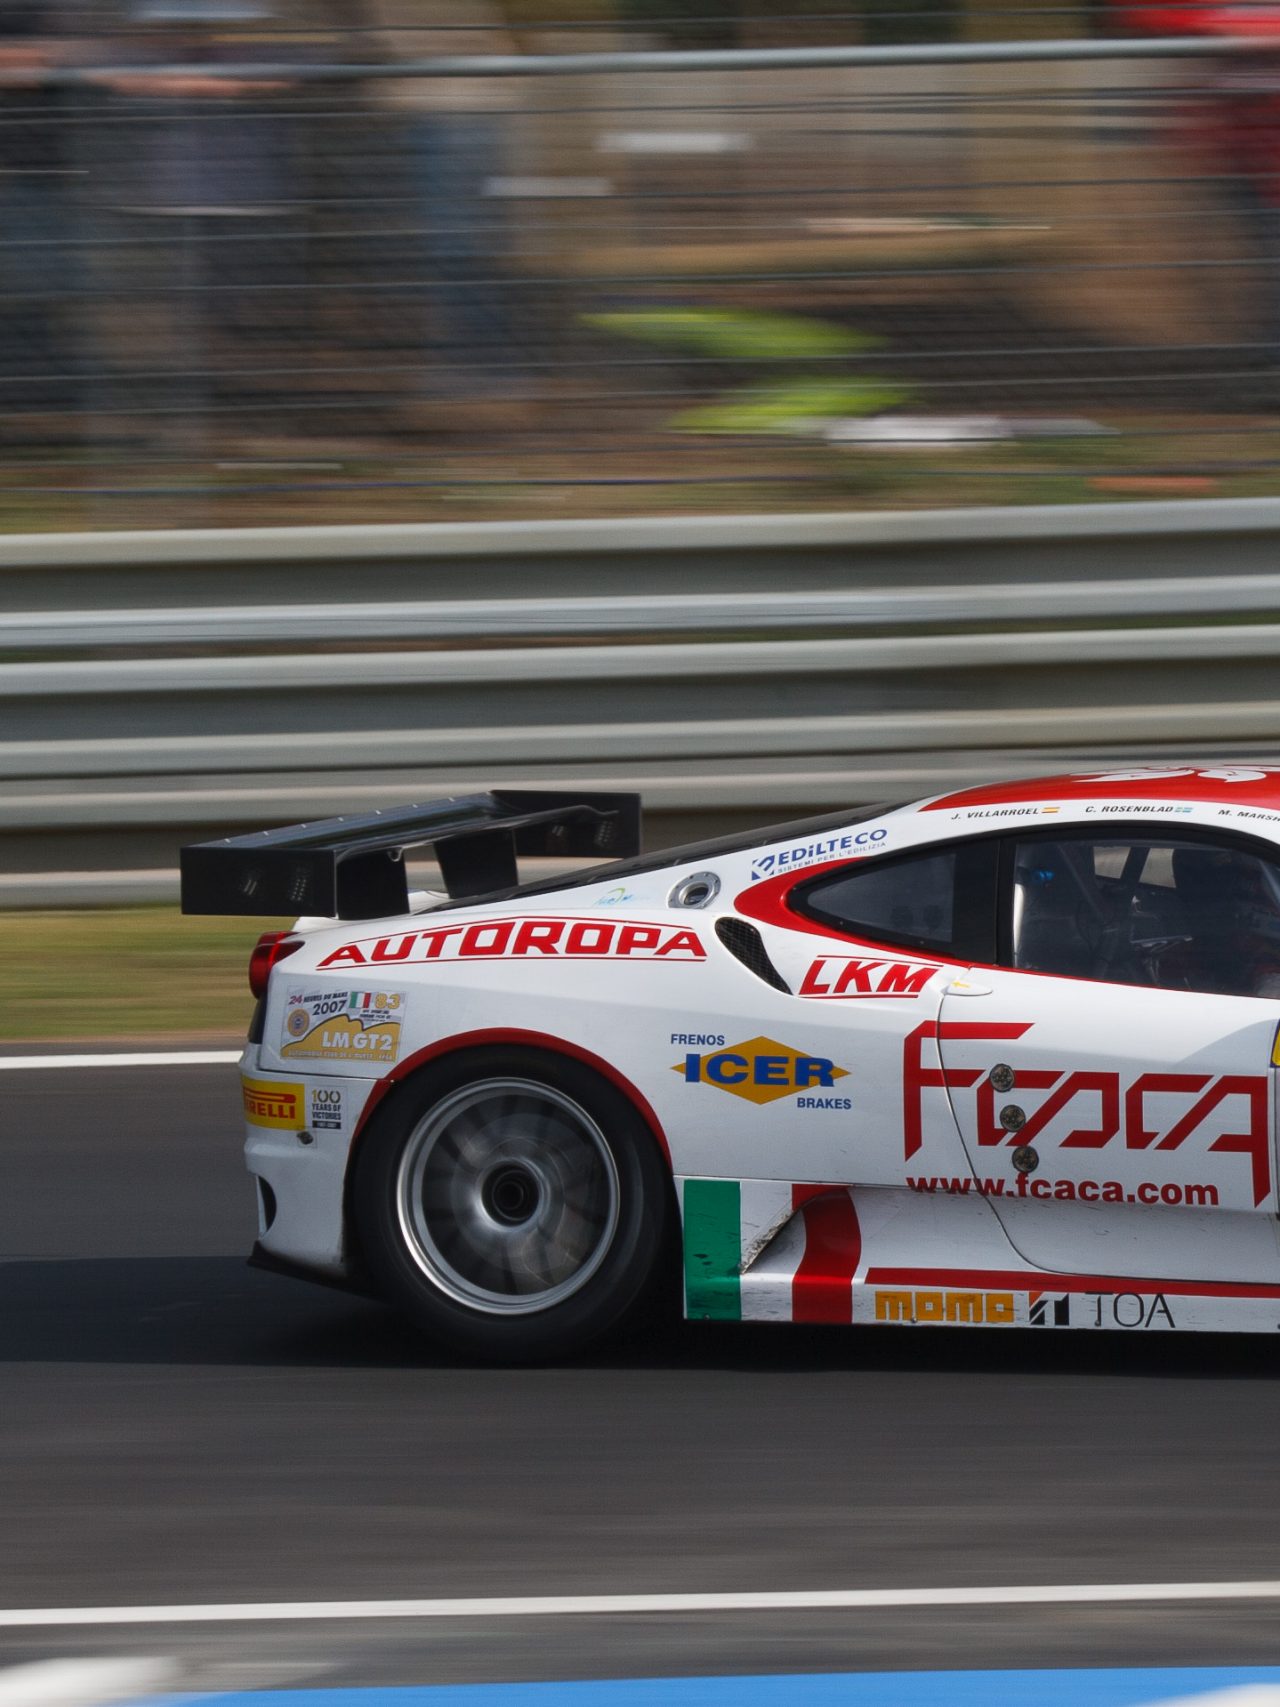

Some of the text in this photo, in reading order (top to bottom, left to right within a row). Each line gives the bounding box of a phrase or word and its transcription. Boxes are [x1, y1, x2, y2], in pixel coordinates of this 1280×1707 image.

[951, 807, 1039, 820] J. VILLARROEL
[1101, 805, 1174, 813] ROSENBLAD
[316, 921, 708, 967] AUTOROPA
[799, 959, 940, 996] LKM
[312, 1000, 348, 1015] 2007
[375, 993, 401, 1009] 83
[670, 1033, 725, 1046] FRENOS
[685, 1053, 835, 1088] ICER
[312, 1088, 341, 1104] 100
[796, 1096, 852, 1110] BRAKES
[905, 1171, 1220, 1206] www.fcaca.com
[1085, 1291, 1176, 1328] TOA
